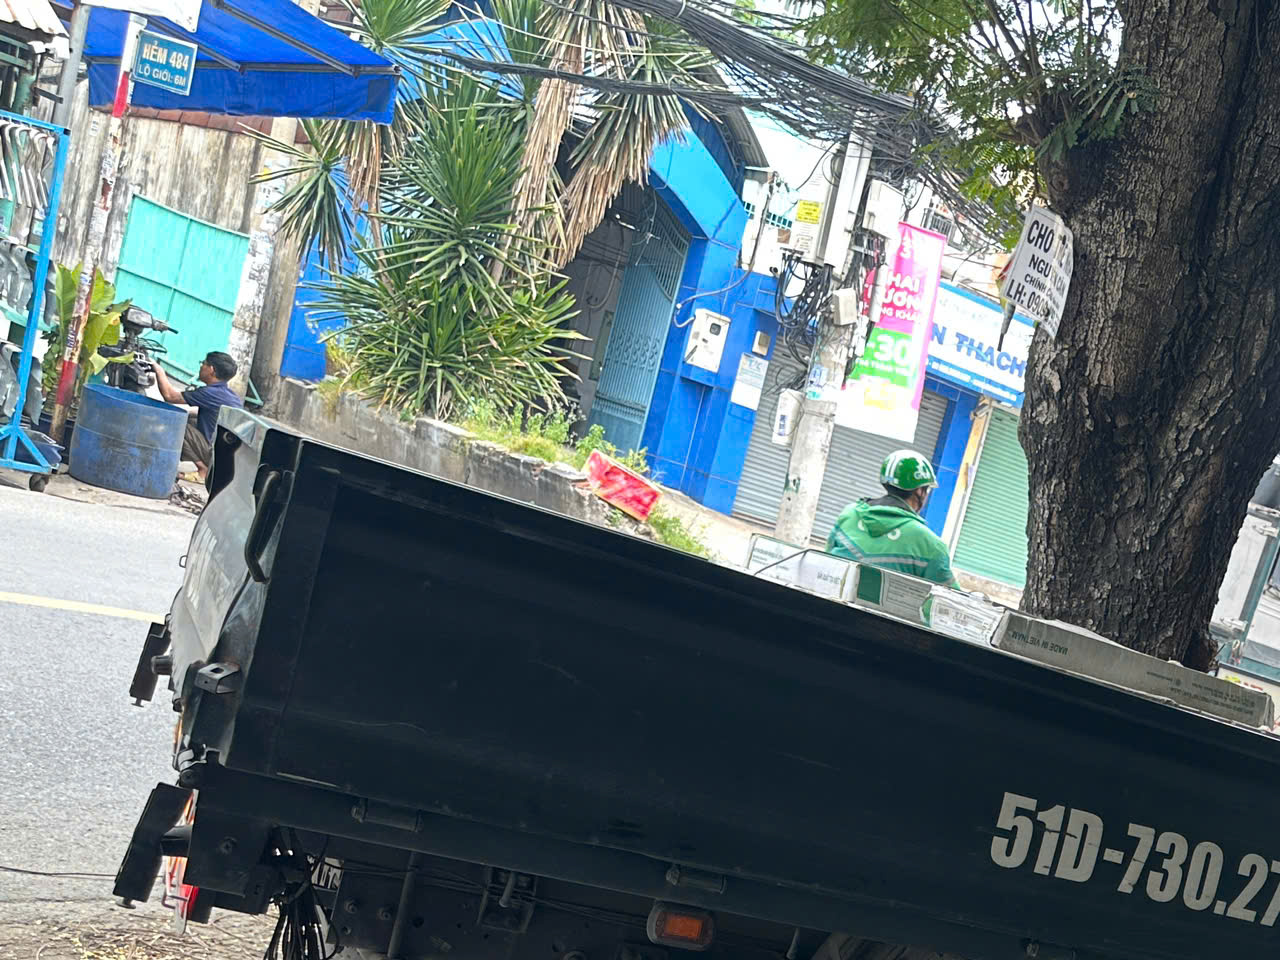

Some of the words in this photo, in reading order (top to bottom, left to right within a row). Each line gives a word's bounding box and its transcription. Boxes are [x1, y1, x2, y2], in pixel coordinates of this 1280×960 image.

[169, 51, 190, 71] 484
[174, 75, 186, 87] 6M
[1027, 219, 1054, 254] CHO
